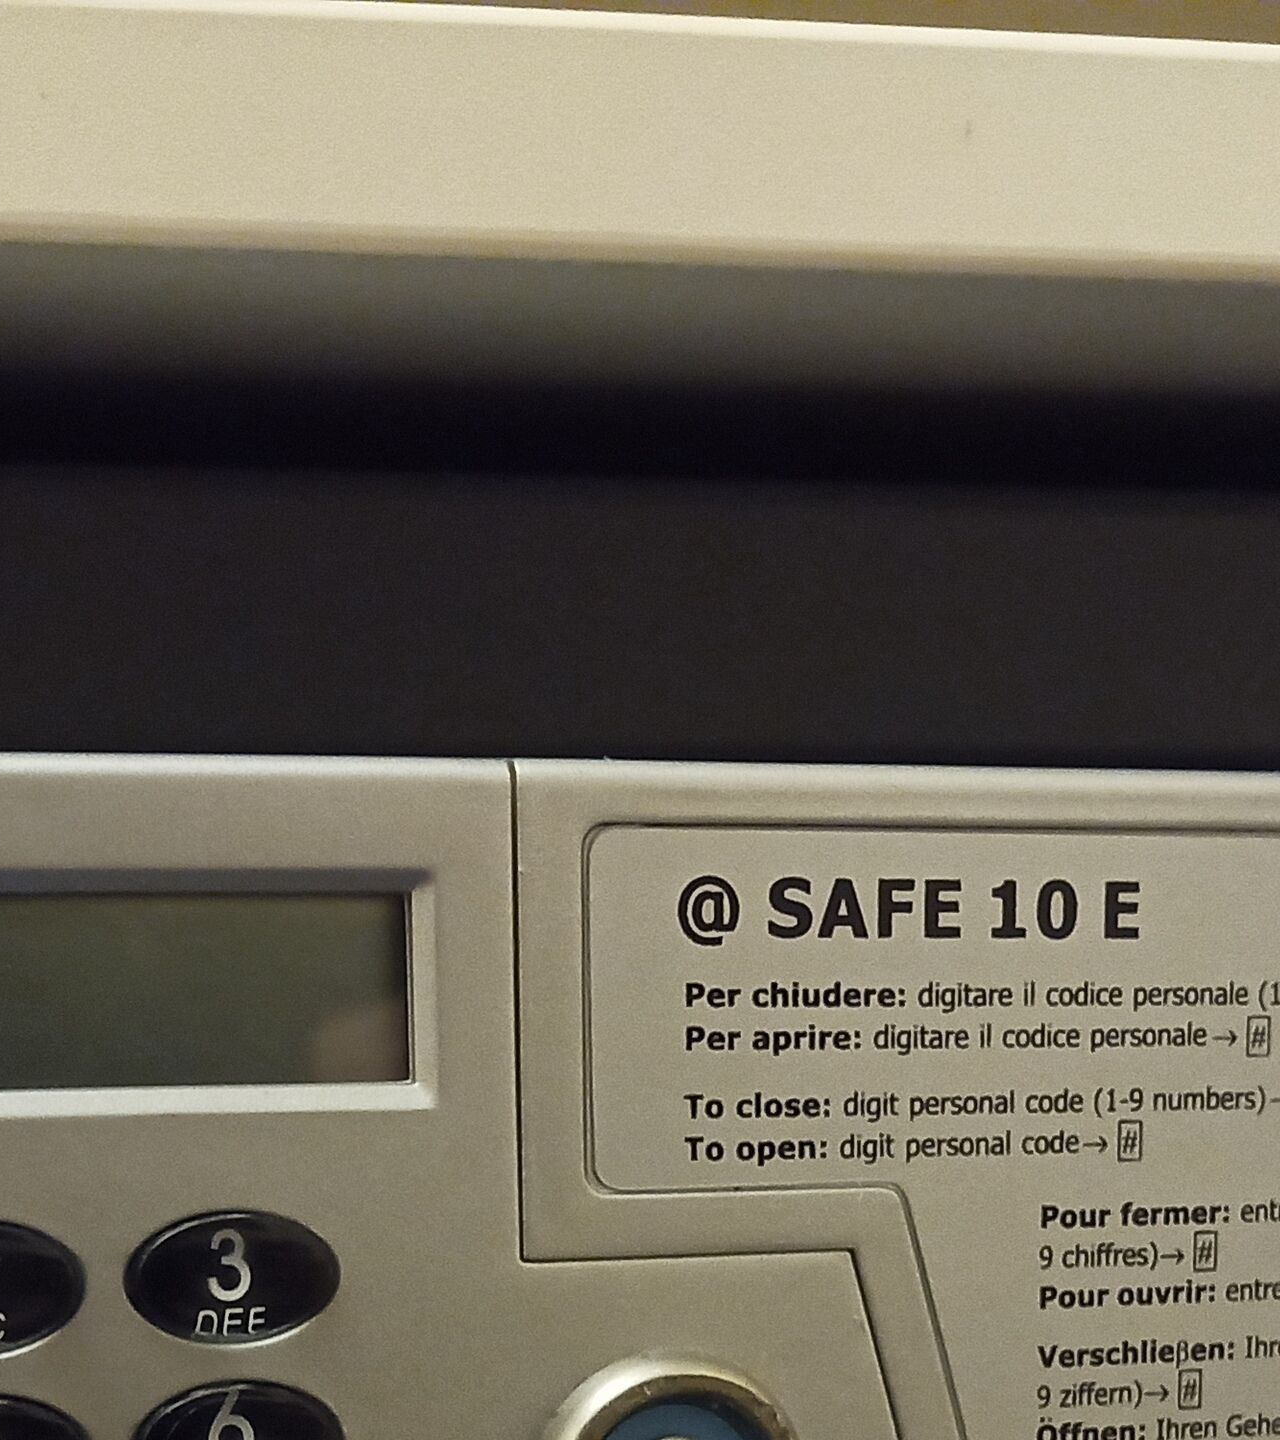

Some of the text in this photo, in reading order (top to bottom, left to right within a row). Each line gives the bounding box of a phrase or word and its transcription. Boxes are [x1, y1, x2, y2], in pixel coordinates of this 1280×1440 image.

[677, 874, 1141, 947] @ SAFE 10 E
[685, 982, 742, 1009] Per
[751, 981, 907, 1009] chiudere:
[917, 980, 1014, 1014] digitare
[1023, 979, 1036, 1007] il
[1045, 980, 1123, 1007] codice
[1133, 980, 1249, 1012] personale
[685, 1025, 742, 1052] Per
[752, 1023, 862, 1057] aprire:
[873, 1023, 970, 1057] digitare
[979, 1022, 992, 1049] il
[1002, 1022, 1081, 1049] codice
[1090, 1021, 1208, 1054] personale
[683, 1093, 724, 1120] To
[735, 1091, 831, 1119] close:
[843, 1090, 900, 1124] digit
[909, 1089, 1015, 1122] personal
[1025, 1087, 1084, 1114] code
[1093, 1087, 1144, 1119] (1-9
[1152, 1085, 1266, 1116] numbers)
[684, 1135, 725, 1162] To
[735, 1140, 828, 1167] open:
[839, 1132, 895, 1165] digit
[905, 1129, 1011, 1164] personal
[1021, 1129, 1080, 1156] code
[1040, 1204, 1112, 1229] Pour
[1119, 1201, 1230, 1227] fermer:
[207, 1229, 251, 1302] 3
[1039, 1244, 1054, 1271] 9
[1061, 1241, 1159, 1271] chiffres)
[1039, 1285, 1110, 1310] Pour
[1116, 1278, 1216, 1306] ouvrir:
[1036, 1384, 1051, 1410] 9
[1059, 1379, 1143, 1410] ziffern)
